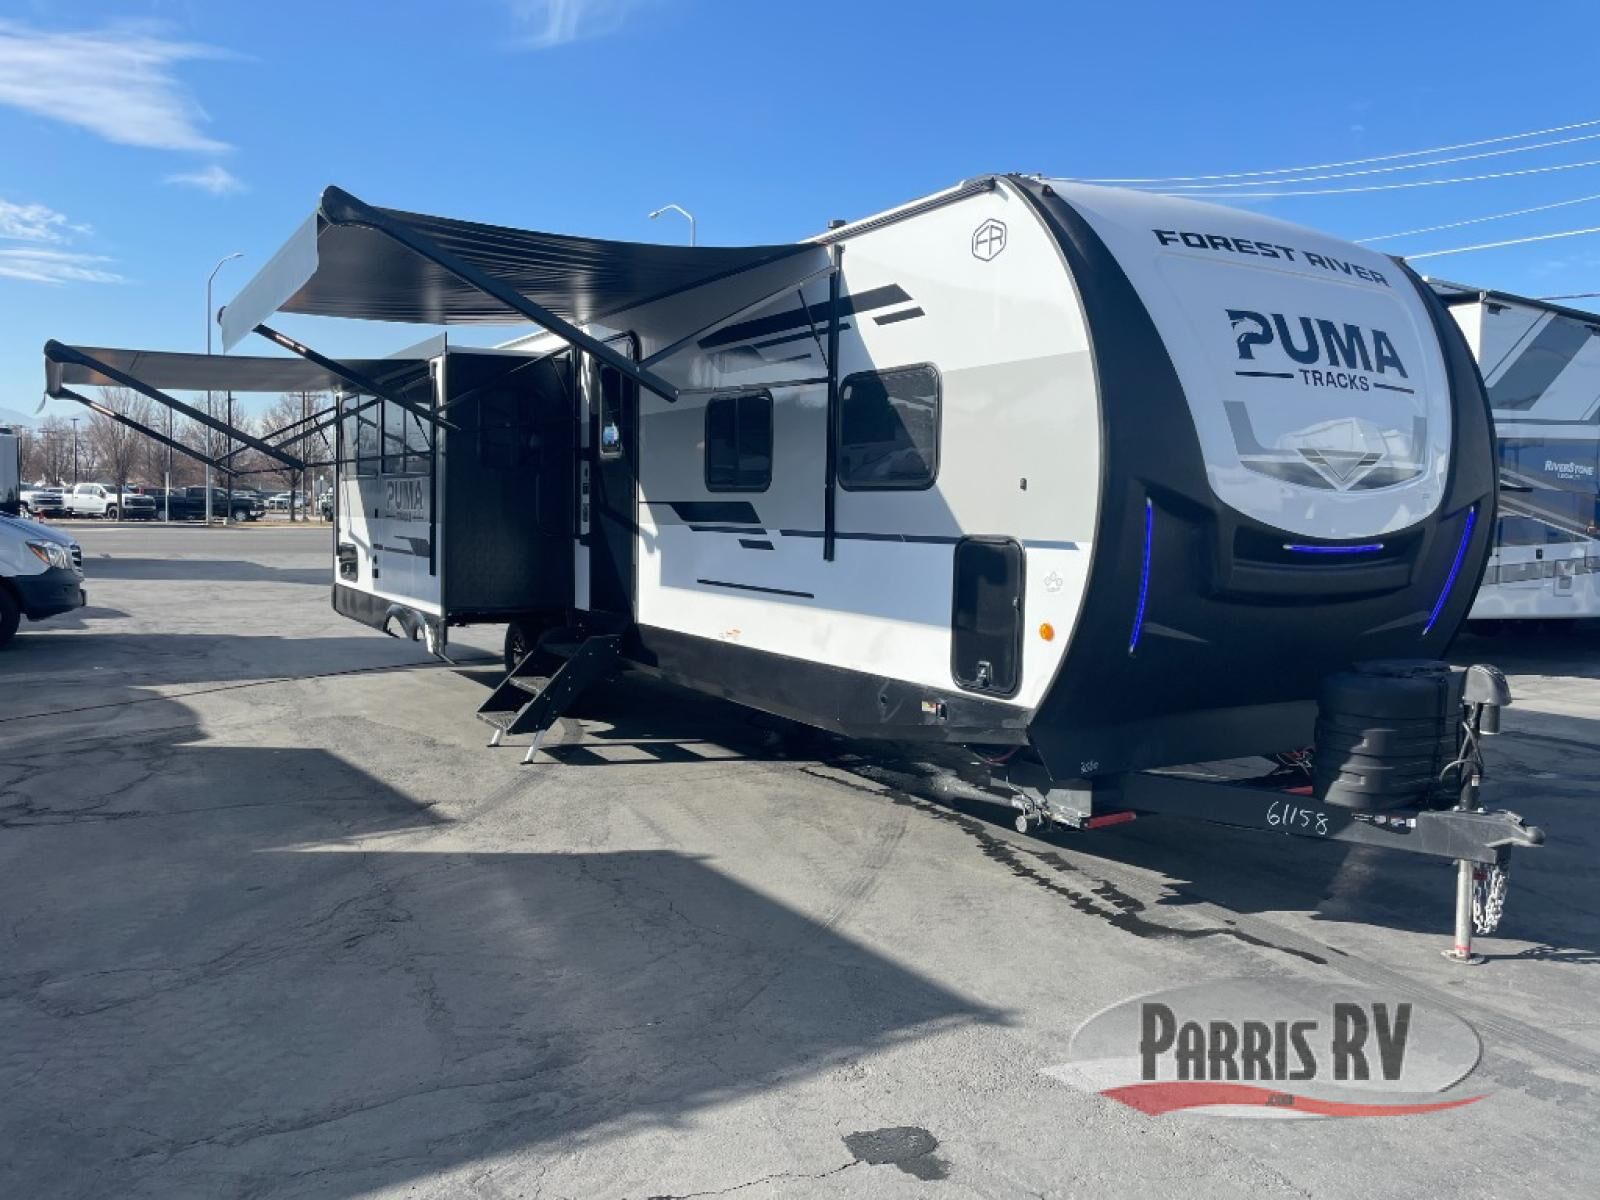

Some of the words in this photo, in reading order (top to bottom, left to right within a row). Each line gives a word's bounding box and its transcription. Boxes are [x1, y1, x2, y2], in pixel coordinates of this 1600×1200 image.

[1152, 229, 1295, 262] FOREST
[1302, 251, 1391, 288] RIVER
[1225, 309, 1408, 379] PUMA
[1299, 368, 1370, 392] TRACKS
[386, 479, 424, 511] PUMA
[1266, 801, 1329, 836] 61158
